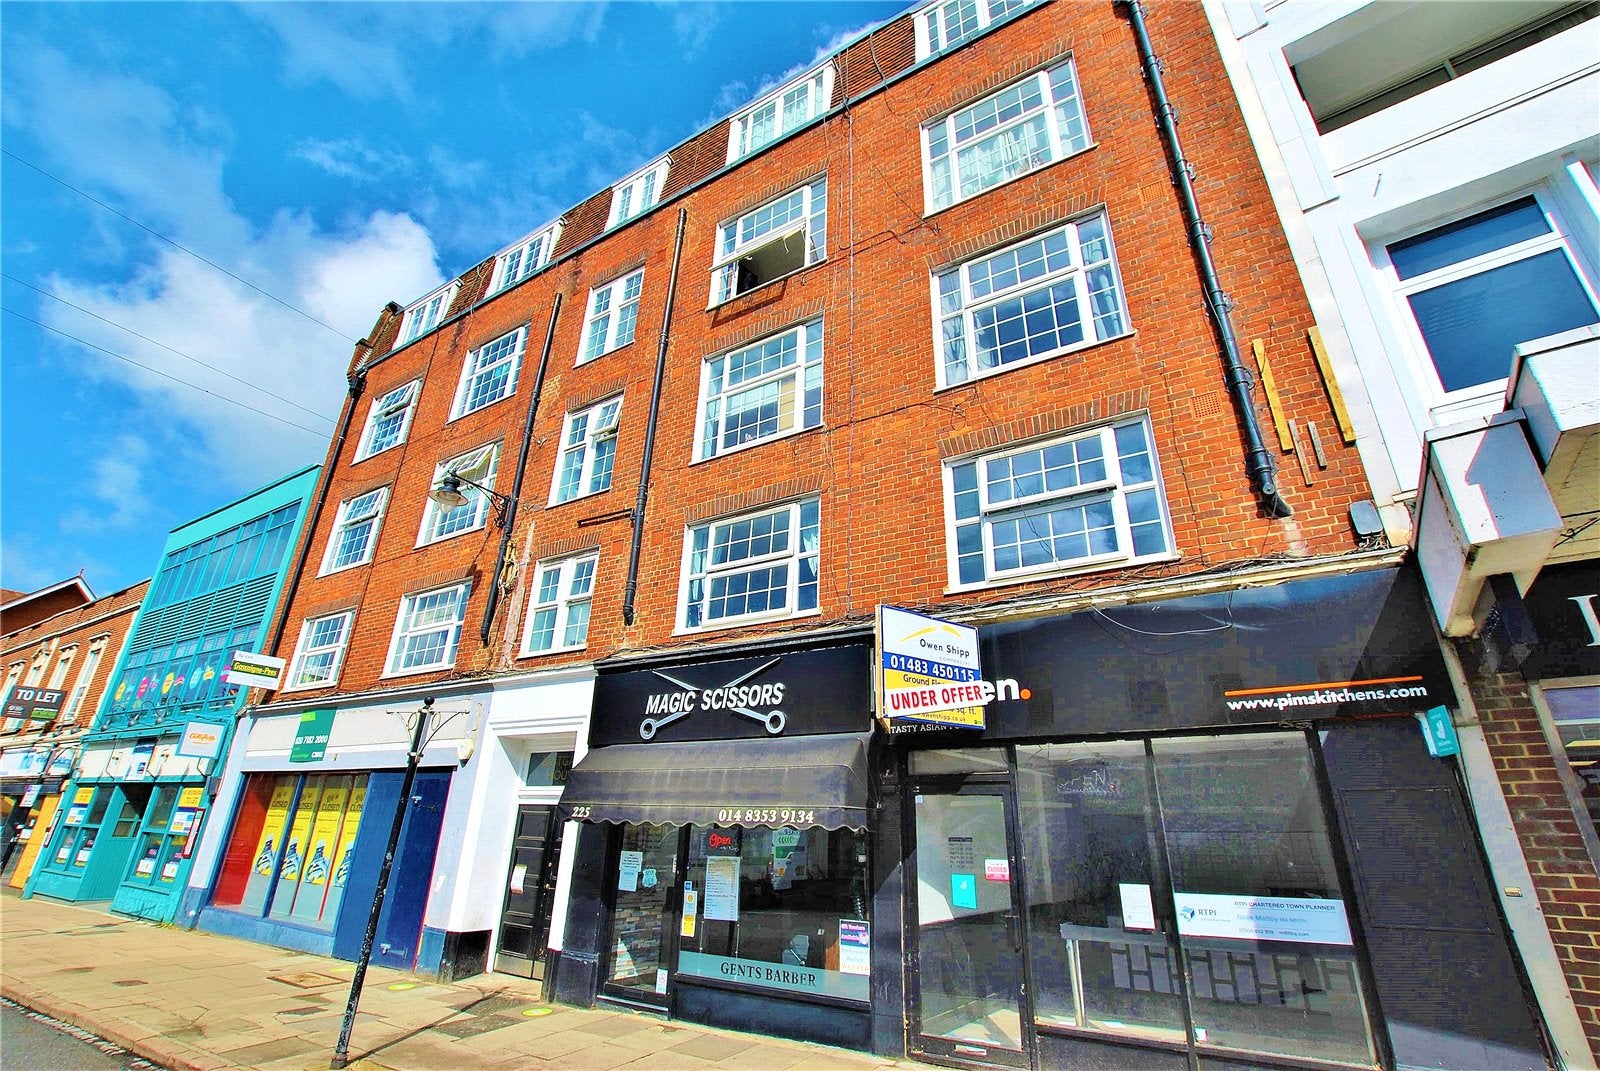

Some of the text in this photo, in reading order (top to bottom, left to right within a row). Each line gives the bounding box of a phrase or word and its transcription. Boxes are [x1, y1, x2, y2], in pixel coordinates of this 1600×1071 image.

[919, 638, 970, 659] Owen Shipp
[890, 654, 974, 682] 01483 450115
[903, 674, 930, 686] Ground
[16, 689, 62, 703] TO LET
[645, 682, 786, 715] MAGIC SCISSORS
[890, 685, 983, 711] UNDER OFFER
[1226, 686, 1429, 711] www.pimskitchens.com
[890, 725, 919, 734] TASTY
[920, 723, 947, 732] ASIAN
[571, 806, 591, 818] 225
[718, 809, 815, 824] 014 8353 9134
[708, 833, 732, 848] Open
[1198, 908, 1217, 917] RTPI
[1248, 901, 1285, 909] CHARTERED
[720, 962, 817, 987] GENTS BARBER
